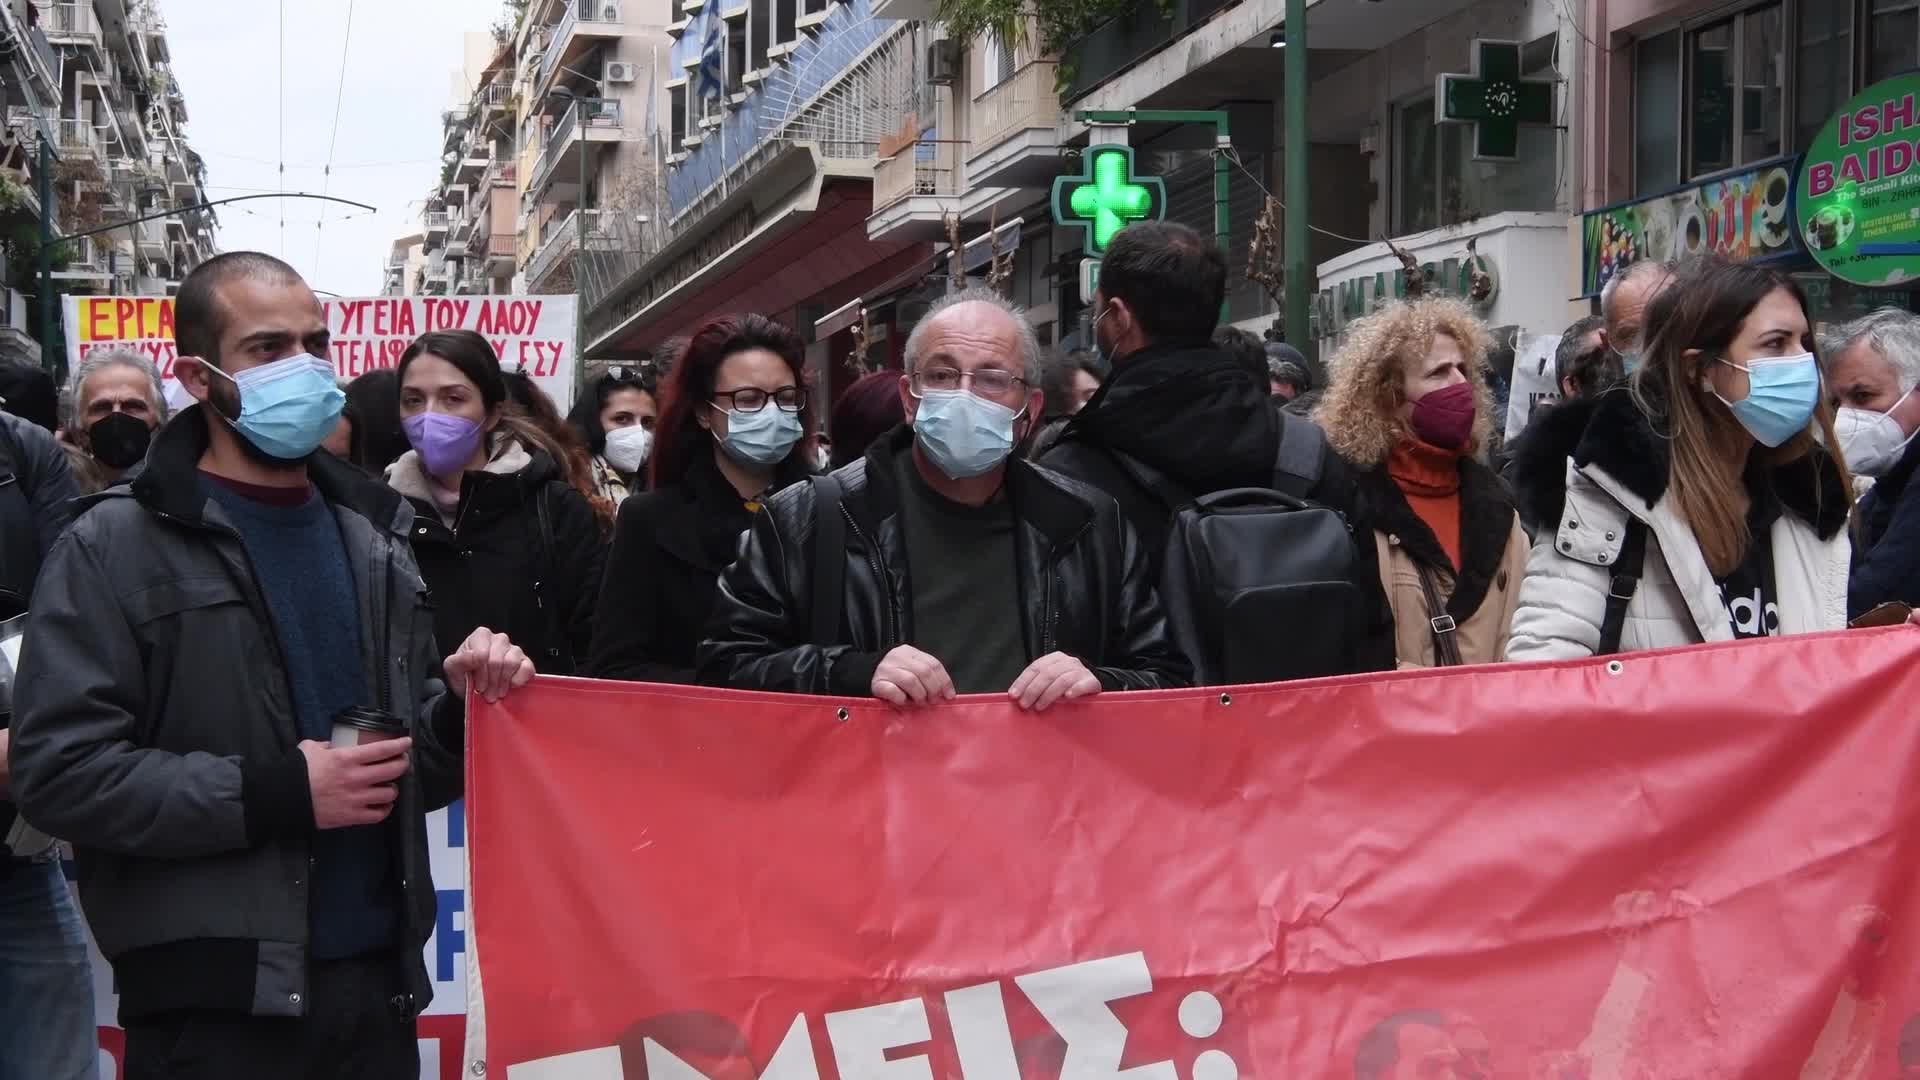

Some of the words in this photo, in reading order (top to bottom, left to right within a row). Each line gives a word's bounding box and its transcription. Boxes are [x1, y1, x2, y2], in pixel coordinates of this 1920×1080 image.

[1839, 93, 1920, 148] ISH
[1808, 140, 1920, 198] BAID
[1860, 179, 1897, 197] Somali
[338, 298, 416, 336] ΥΓΕΙΑ
[422, 297, 470, 331] ΤΟΥ
[476, 299, 543, 336] ΛΑΟΥ
